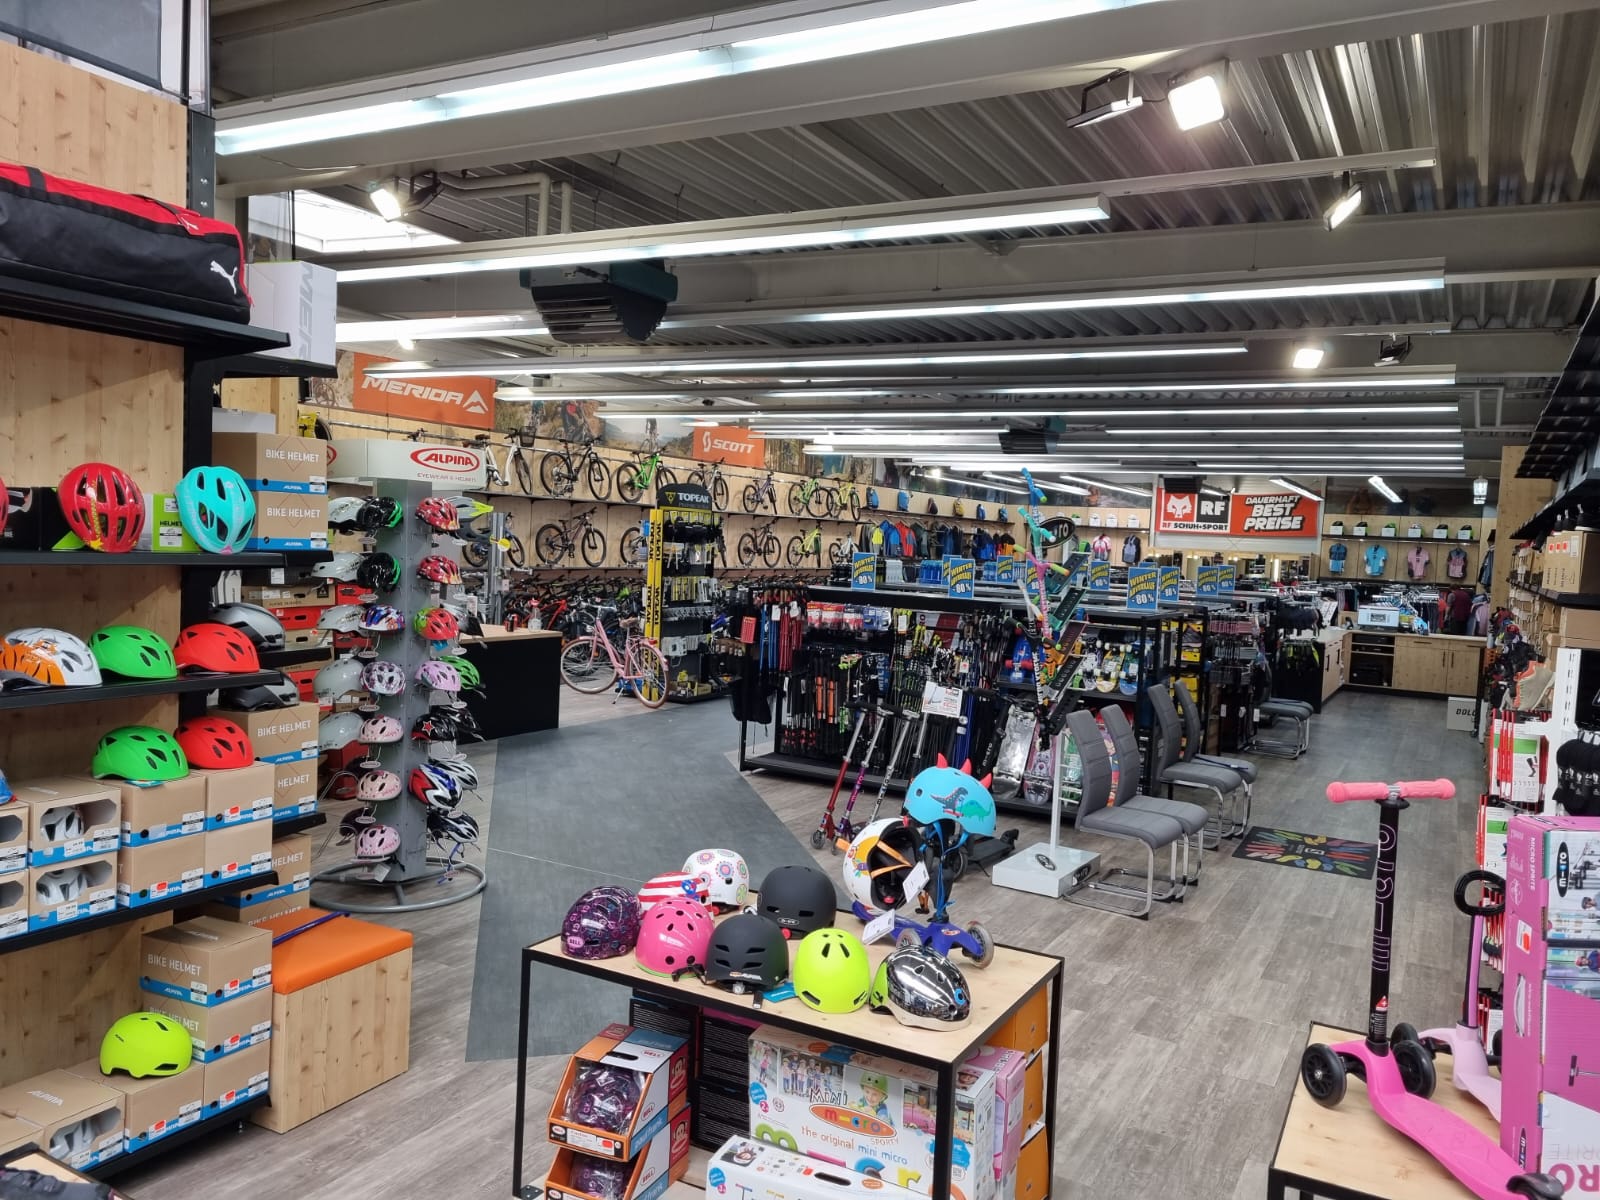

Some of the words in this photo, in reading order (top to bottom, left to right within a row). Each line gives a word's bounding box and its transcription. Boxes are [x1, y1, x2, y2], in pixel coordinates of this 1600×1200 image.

[361, 375, 464, 405] MERIDA
[711, 438, 755, 454] SCOTT
[265, 448, 286, 459] BIKE
[287, 450, 320, 463] HELMET
[423, 452, 474, 467] ALPINA
[678, 492, 710, 503] TOPEAK
[1245, 495, 1300, 505] DAUERHAFT
[266, 507, 286, 517] BIKE
[288, 508, 321, 518] HELMET
[1200, 500, 1226, 517] RF
[1251, 503, 1296, 517] BEST
[1243, 516, 1304, 531] PREISE
[1129, 571, 1157, 586] WINTER
[257, 727, 277, 737] BIKE
[279, 720, 312, 734] HELMET
[277, 774, 310, 789] HELMET
[271, 852, 304, 867] HELMET
[147, 953, 167, 967] BIKE
[169, 959, 202, 976] HELMET
[801, 1125, 818, 1138] the
[820, 1130, 855, 1151] original
[857, 1144, 879, 1159] mini
[881, 1152, 908, 1166] micro
[870, 1137, 899, 1146] SPORTY
